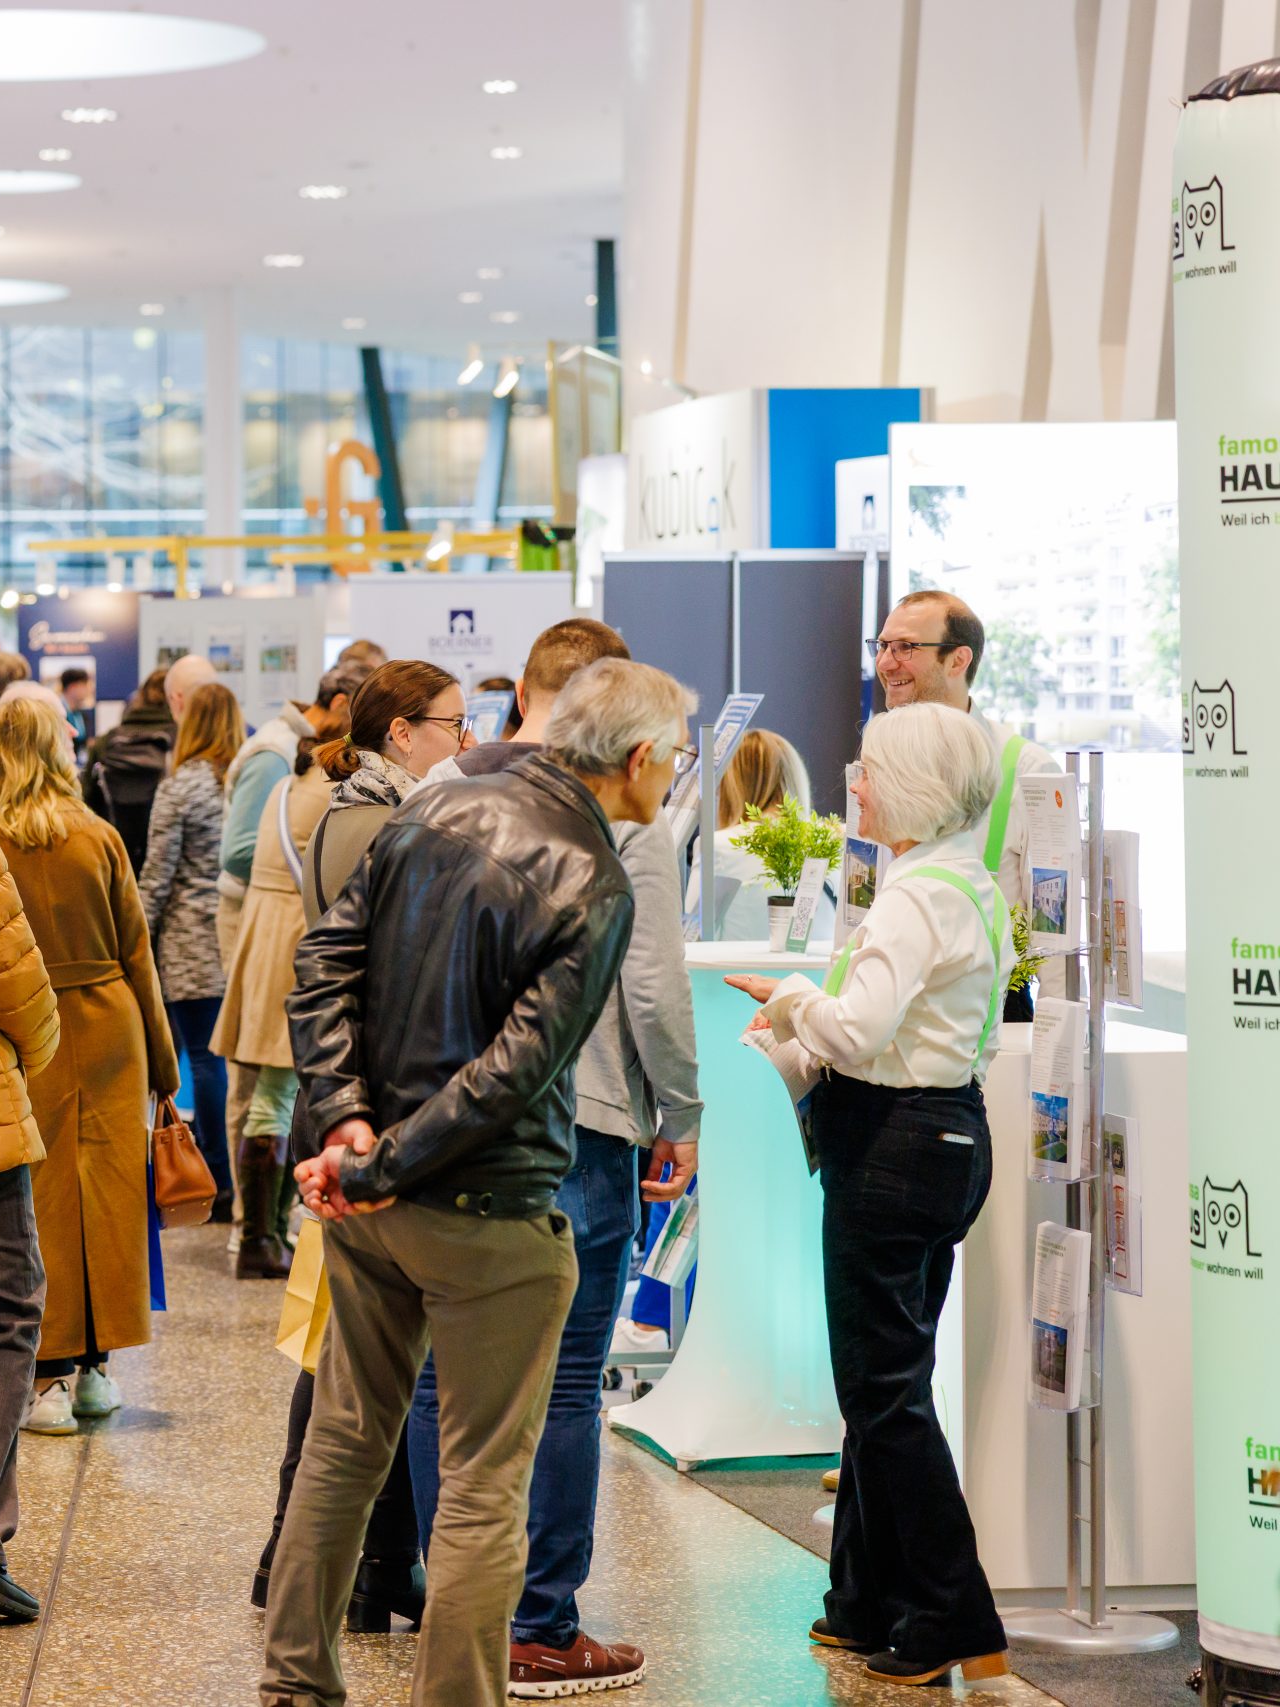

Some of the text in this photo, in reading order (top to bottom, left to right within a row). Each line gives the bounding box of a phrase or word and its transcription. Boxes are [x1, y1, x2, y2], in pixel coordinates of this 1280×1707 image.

[1219, 261, 1236, 274] will
[1221, 514, 1247, 526] Weil
[1251, 513, 1270, 525] ich
[1231, 766, 1248, 777] will
[1232, 937, 1280, 959] fam
[1233, 968, 1280, 996] HA
[1234, 1016, 1260, 1029] Weil
[1207, 1262, 1240, 1277] wohnen
[1244, 1267, 1263, 1279] will
[1250, 1515, 1277, 1530] Weil
